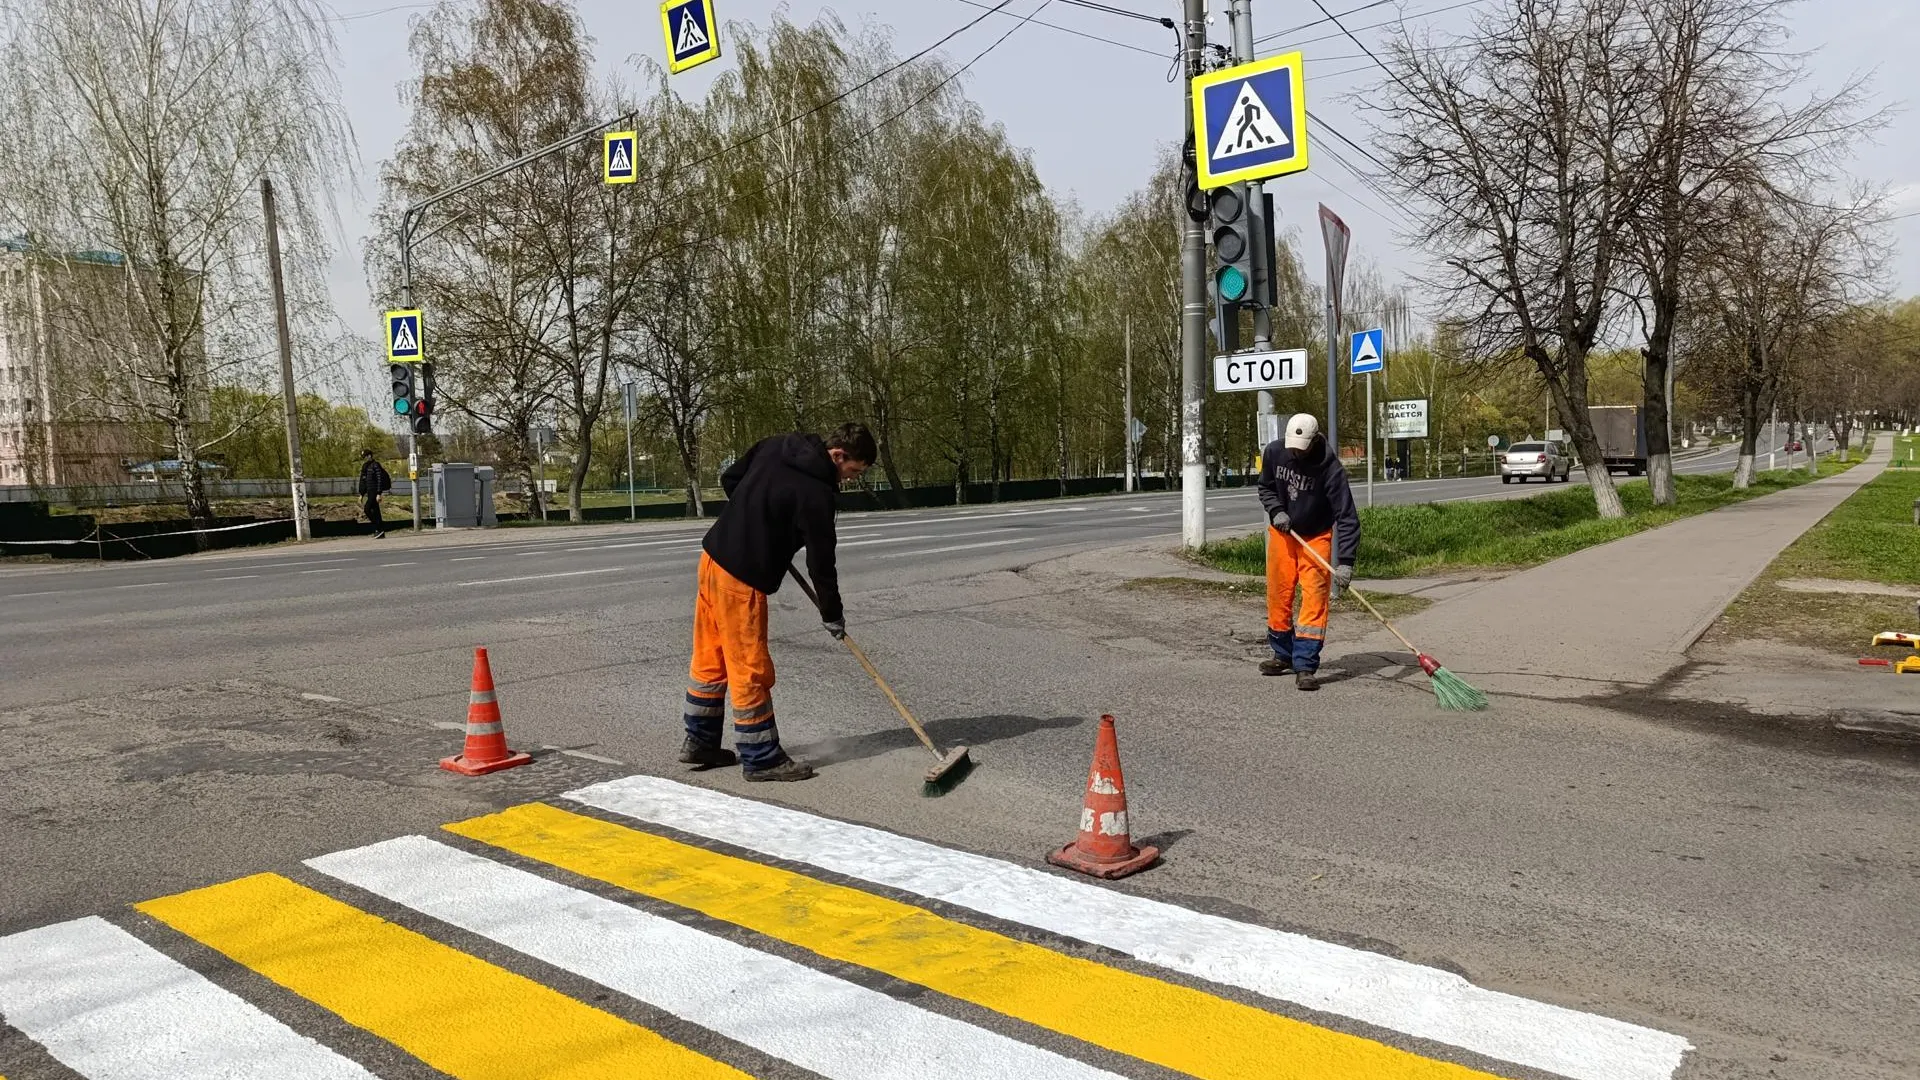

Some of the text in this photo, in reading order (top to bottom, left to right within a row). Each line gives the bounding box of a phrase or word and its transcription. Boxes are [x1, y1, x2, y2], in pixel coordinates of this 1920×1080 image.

[1227, 358, 1293, 384] СТОП
[1387, 403, 1417, 411] МЕСТО
[1387, 411, 1423, 419] ДАЕТСЯ
[1276, 465, 1314, 491] RUSSIA
